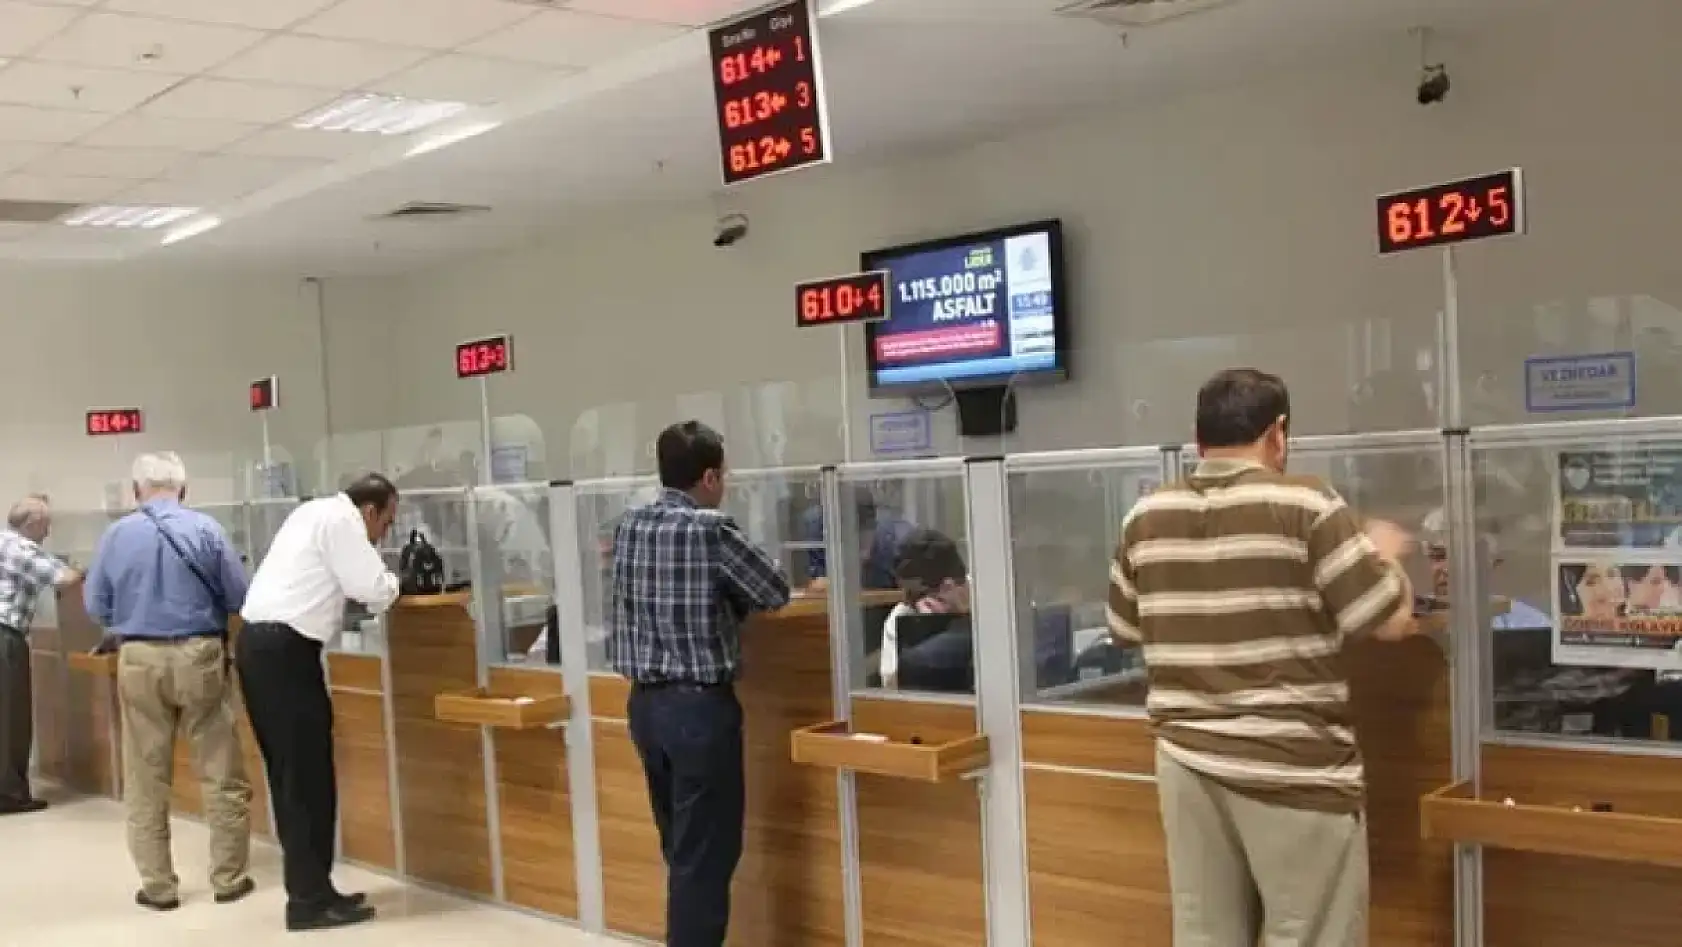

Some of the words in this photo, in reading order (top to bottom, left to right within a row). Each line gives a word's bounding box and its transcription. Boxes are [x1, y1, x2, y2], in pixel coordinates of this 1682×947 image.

[720, 46, 766, 85] 614
[724, 91, 773, 128] 613
[795, 81, 810, 107] 3
[730, 135, 778, 172] 612
[801, 127, 816, 153] 5
[1387, 191, 1466, 243] 612
[1488, 187, 1509, 226] 5
[801, 285, 853, 320] 610
[932, 292, 996, 322] ASFALT
